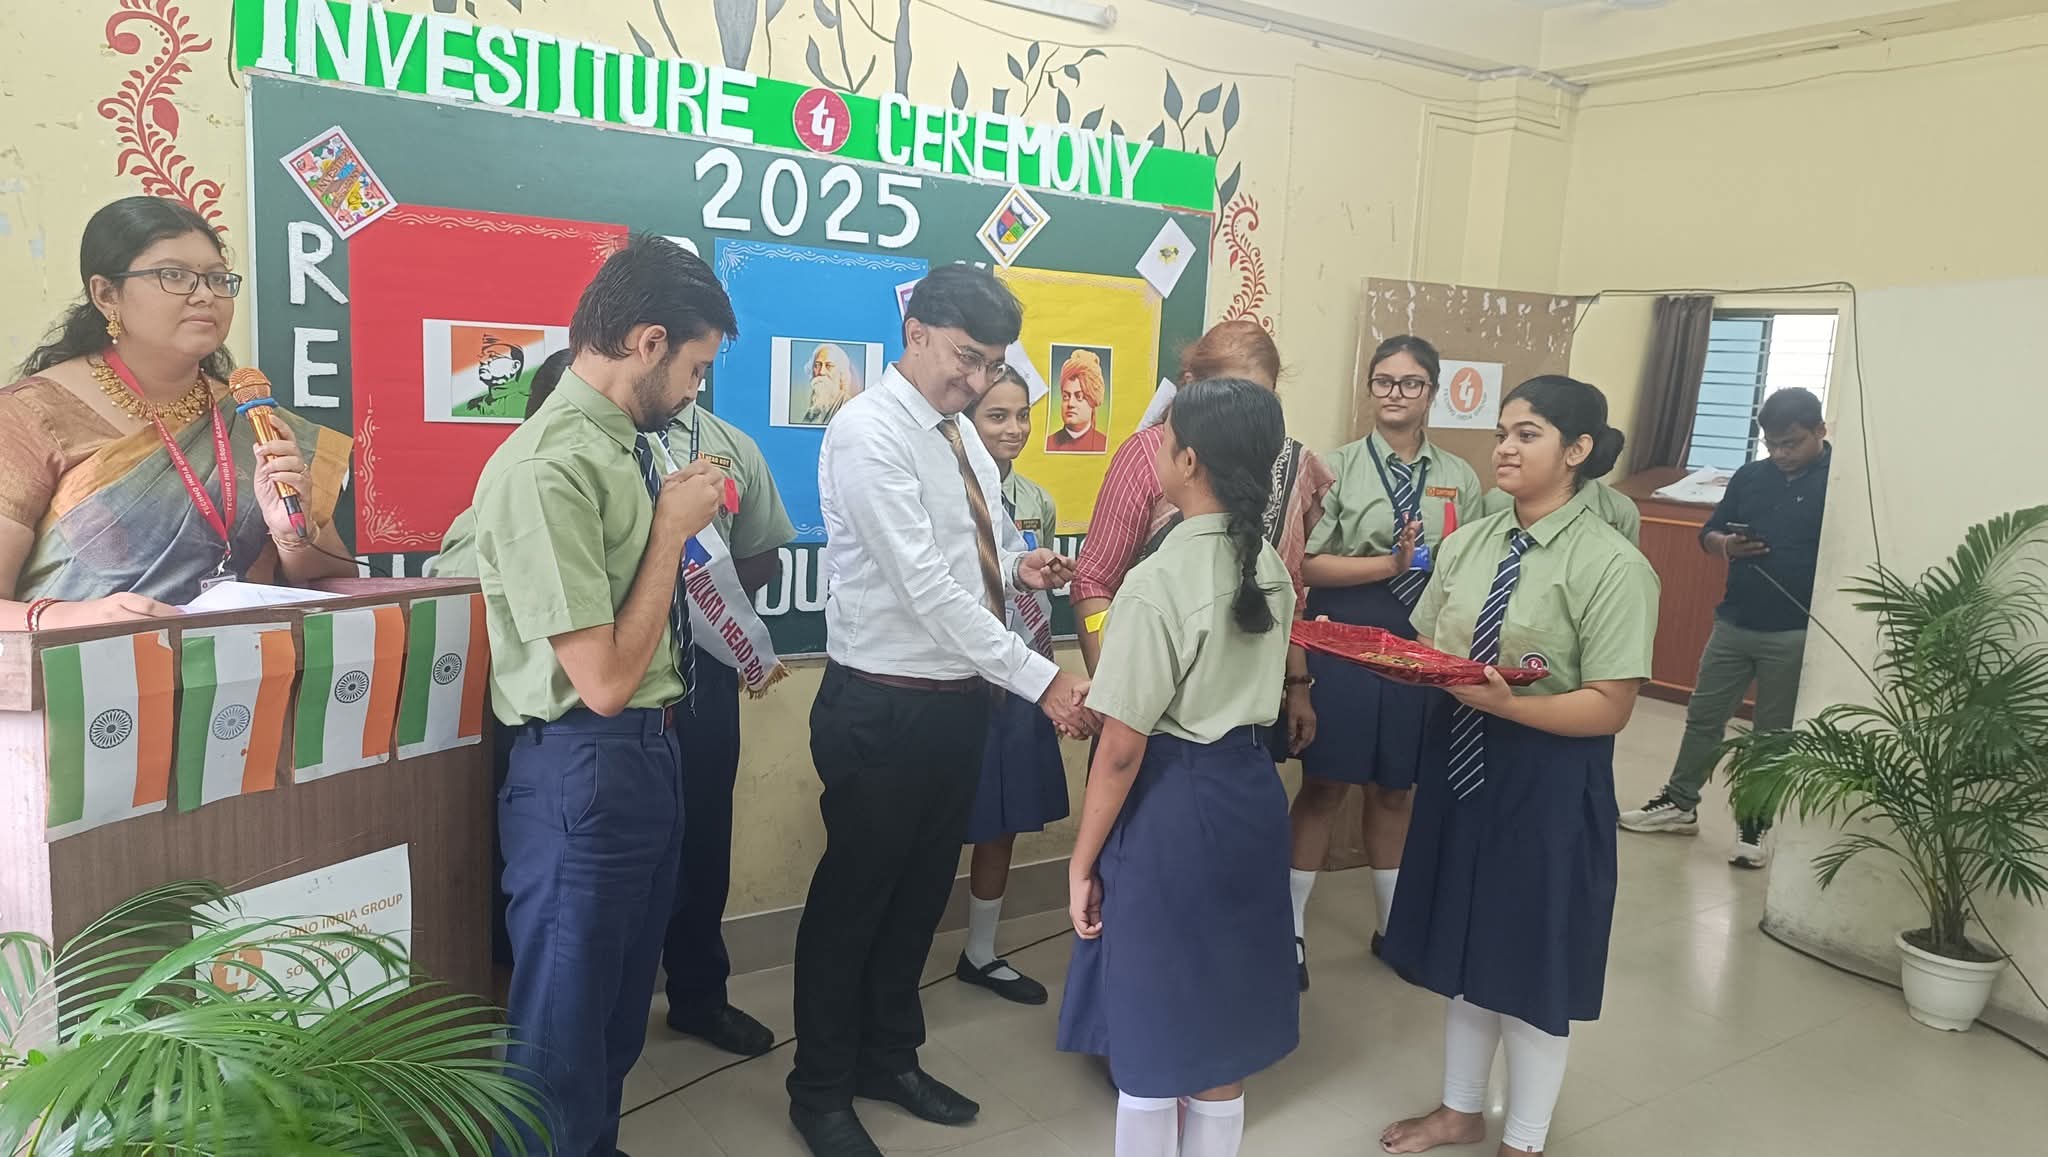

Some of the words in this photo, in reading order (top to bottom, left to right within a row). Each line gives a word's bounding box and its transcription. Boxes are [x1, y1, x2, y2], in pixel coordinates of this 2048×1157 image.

[255, 0, 757, 144] INVESTITURE
[877, 92, 1154, 200] CEREMONY
[695, 147, 922, 248] 2025
[181, 466, 194, 486] INDIA
[221, 461, 230, 480] INDIA
[686, 568, 727, 627] KOLKATA
[719, 616, 754, 664] HEAD
[743, 655, 765, 687] BOY
[322, 908, 358, 930] INDIA
[361, 893, 403, 917] GROUP
